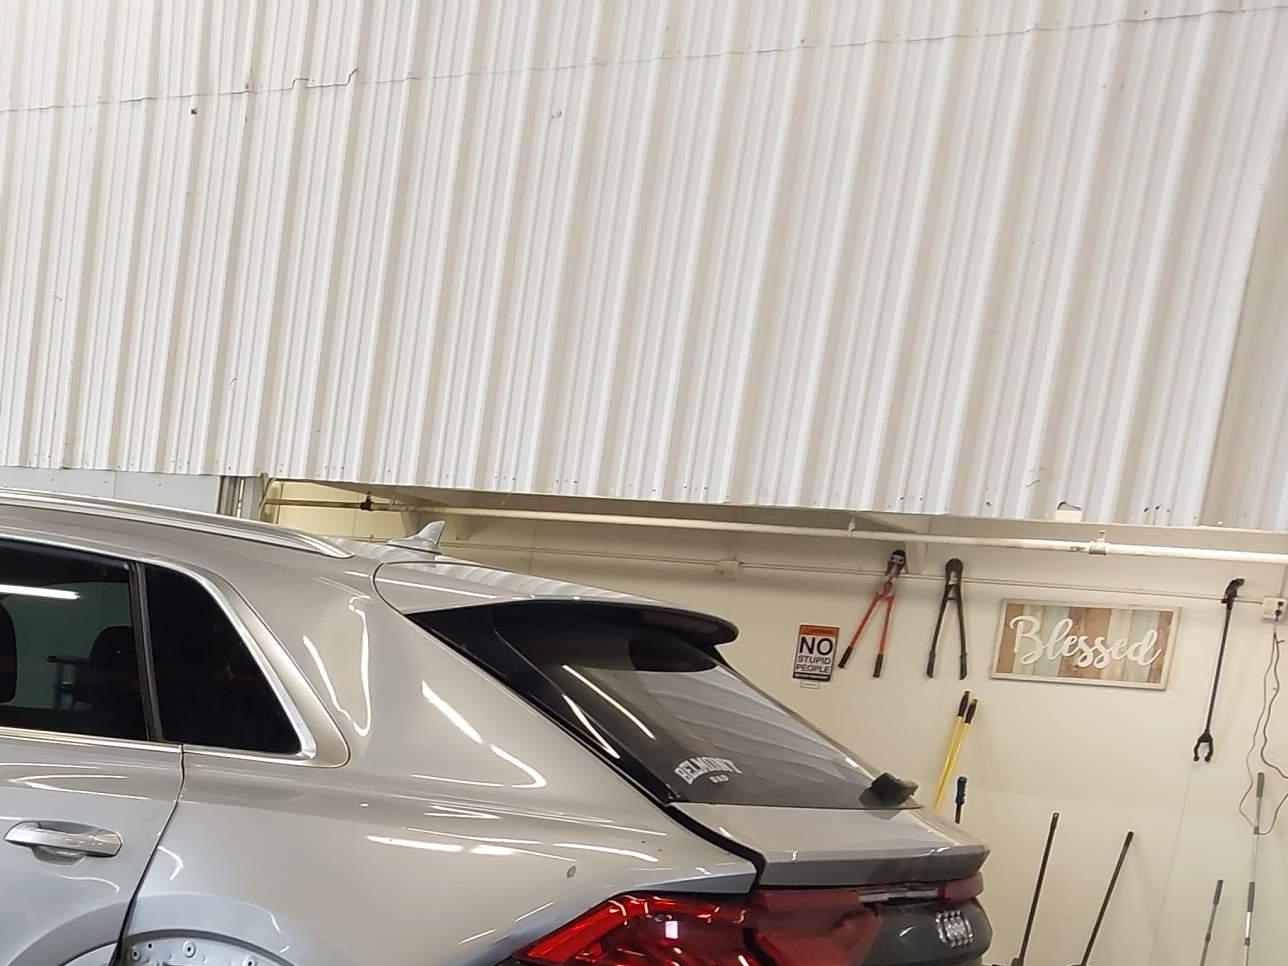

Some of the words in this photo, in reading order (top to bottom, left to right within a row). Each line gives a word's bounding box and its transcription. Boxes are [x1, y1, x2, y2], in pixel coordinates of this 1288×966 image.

[799, 636, 834, 656] NO
[1009, 615, 1162, 669] Blessed
[797, 655, 832, 665] STUPID
[796, 663, 831, 673] PEOPLE
